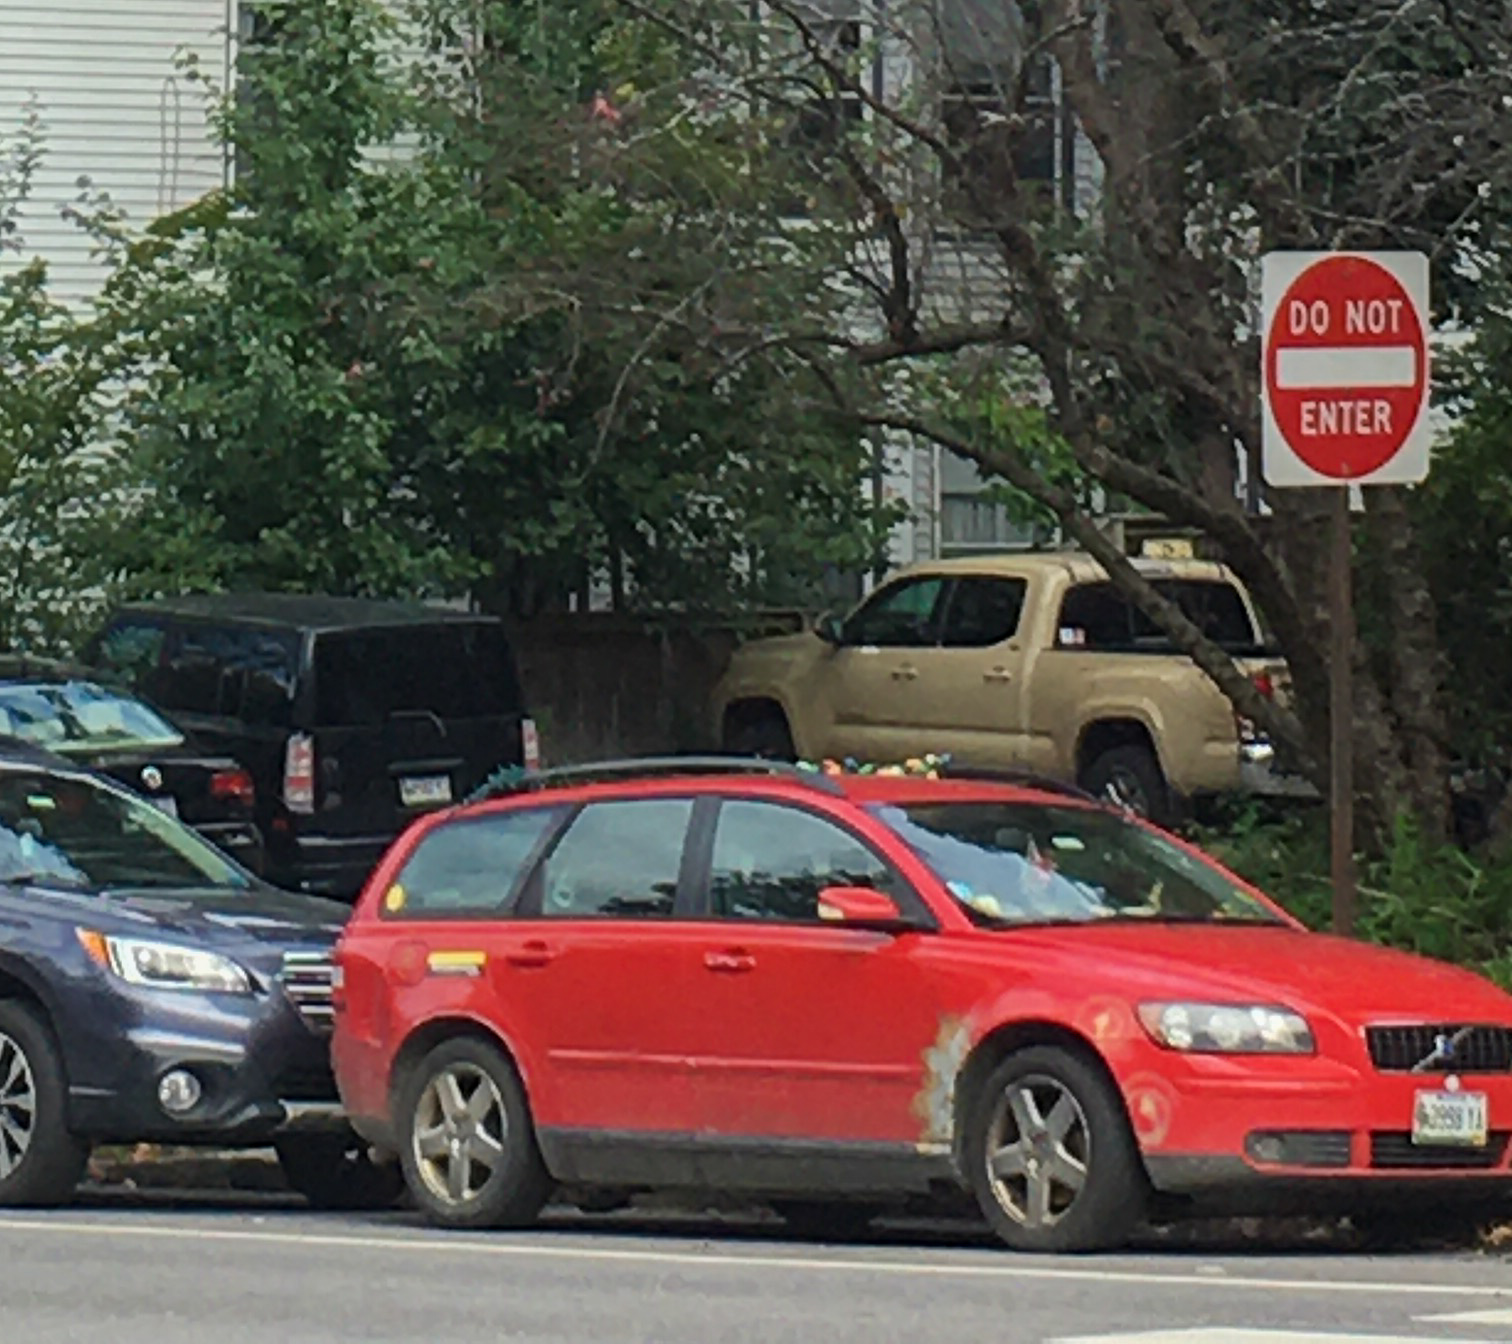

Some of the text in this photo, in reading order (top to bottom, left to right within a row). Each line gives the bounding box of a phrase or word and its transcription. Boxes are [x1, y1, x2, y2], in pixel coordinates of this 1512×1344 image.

[1290, 300, 1402, 334] DO NOT
[1300, 400, 1392, 434] ENTER
